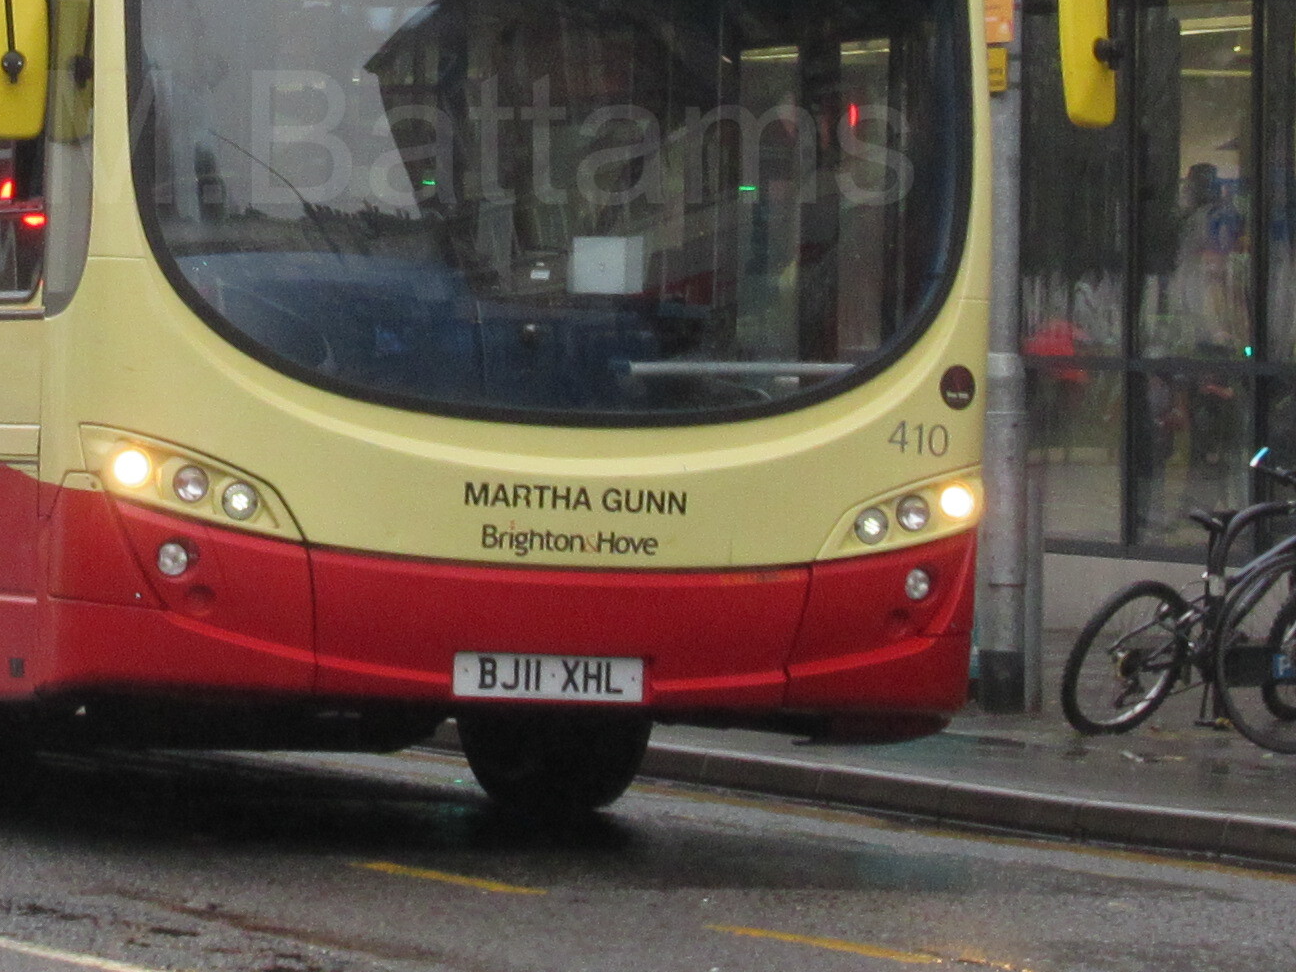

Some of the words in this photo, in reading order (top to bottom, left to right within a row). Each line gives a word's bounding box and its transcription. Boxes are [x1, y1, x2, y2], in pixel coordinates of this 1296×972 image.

[888, 419, 949, 457] 410
[464, 481, 592, 512] MARTHA
[601, 487, 688, 516] GUNN
[478, 656, 542, 692] BJ11
[561, 658, 624, 695] XHL
